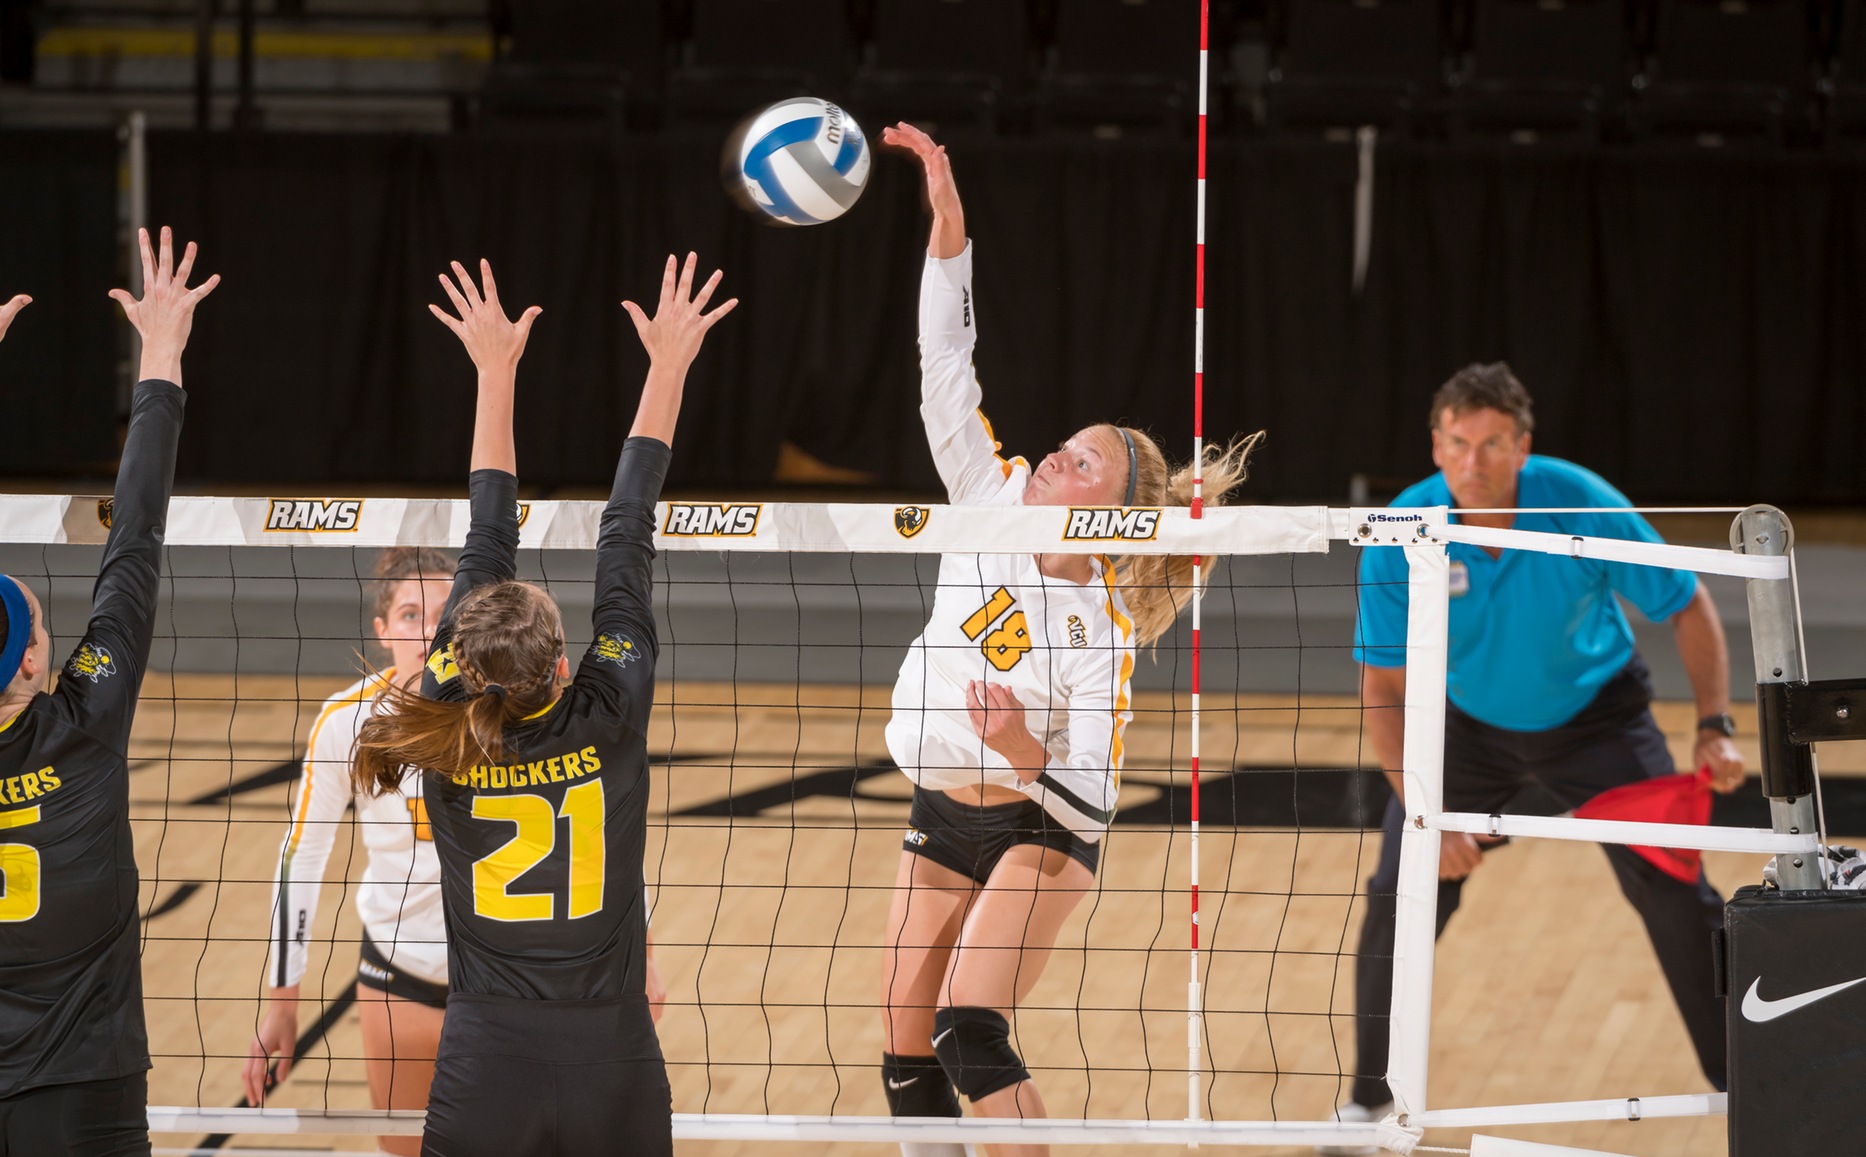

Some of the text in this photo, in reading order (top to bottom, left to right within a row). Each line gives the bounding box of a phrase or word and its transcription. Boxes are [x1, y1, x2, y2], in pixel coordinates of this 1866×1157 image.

[266, 499, 362, 530] RAMS
[664, 504, 761, 535] RAMS
[1064, 508, 1161, 540] RAMS
[1376, 514, 1423, 523] Senoh
[960, 585, 1032, 671] 18
[1067, 614, 1088, 649] VCU
[471, 776, 606, 922] 21
